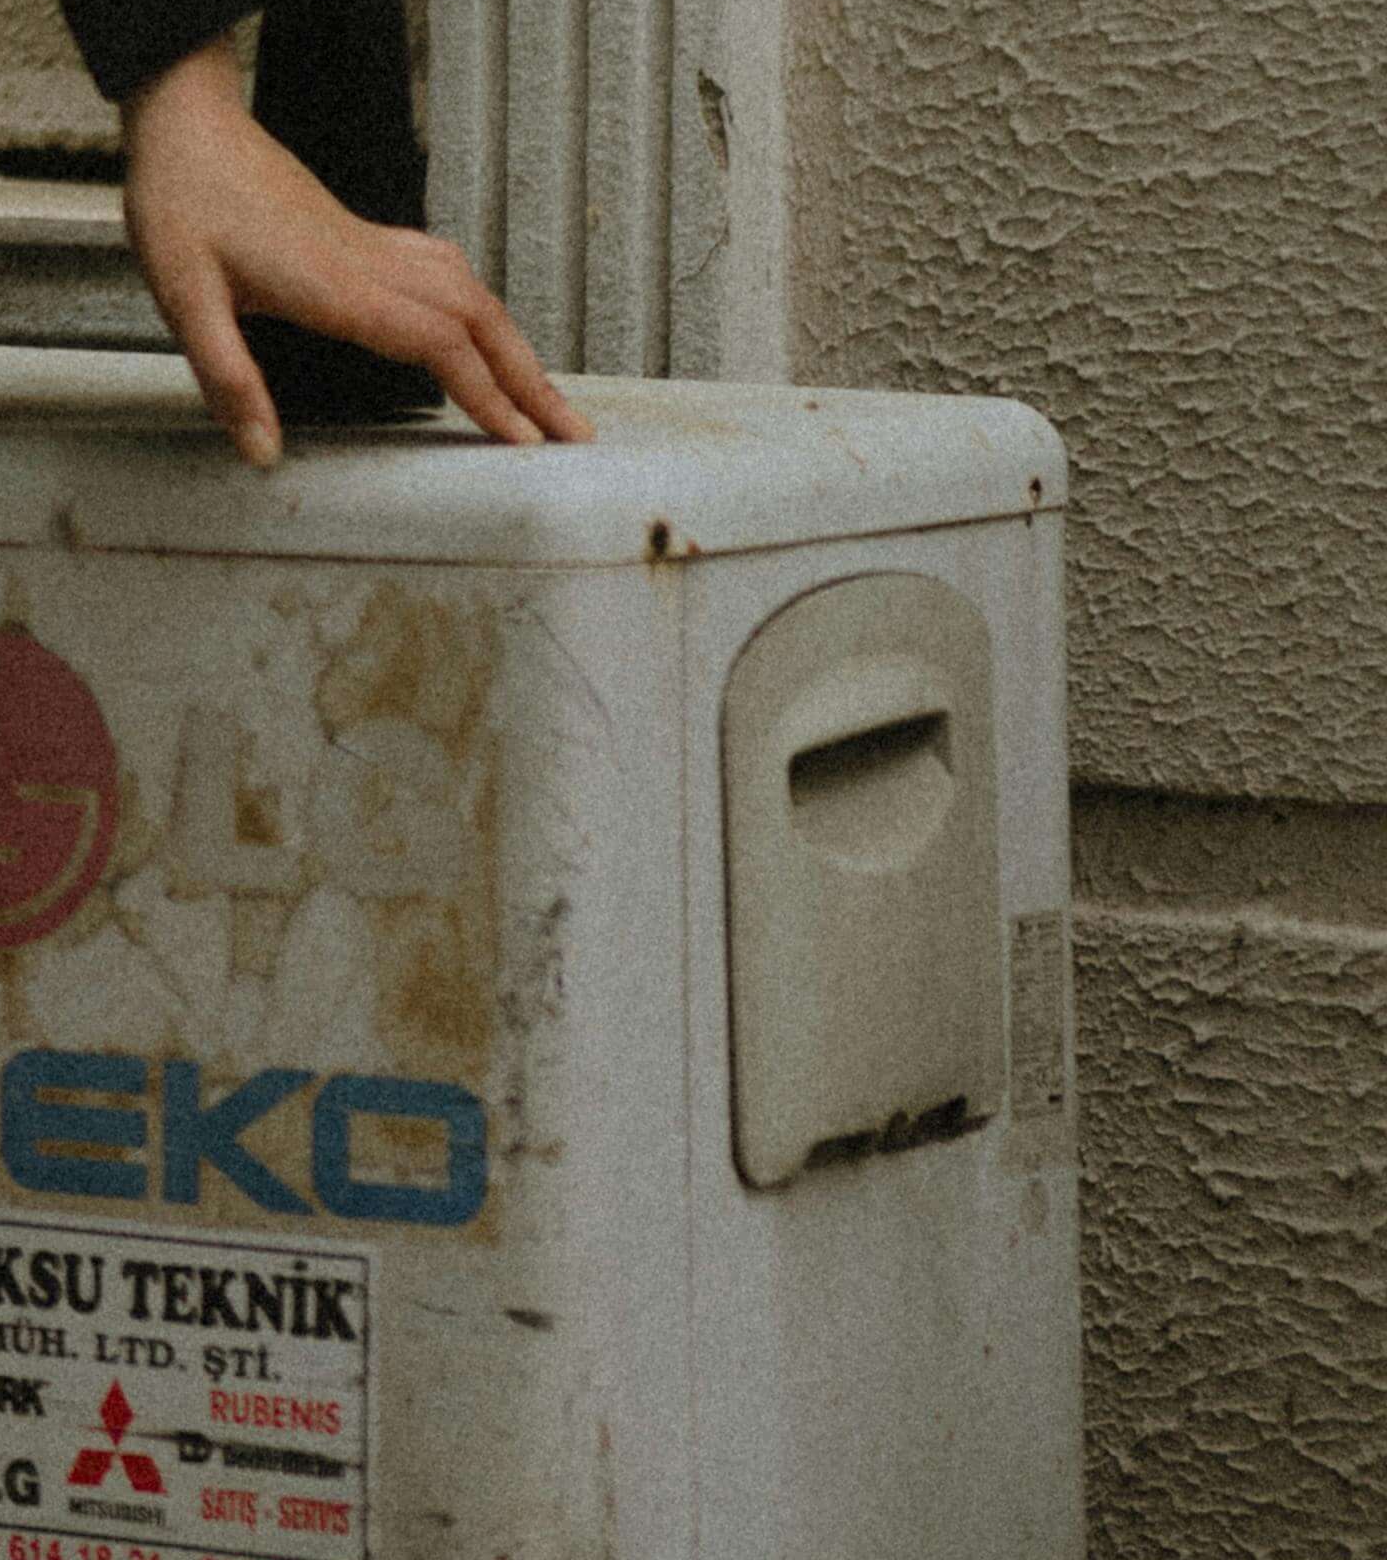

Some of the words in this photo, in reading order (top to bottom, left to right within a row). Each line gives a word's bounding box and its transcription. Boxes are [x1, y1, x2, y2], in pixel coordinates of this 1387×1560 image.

[122, 1259, 357, 1341] TEKNİK
[95, 1333, 187, 1370] LTD.
[203, 1343, 280, 1382] ŞTİ.
